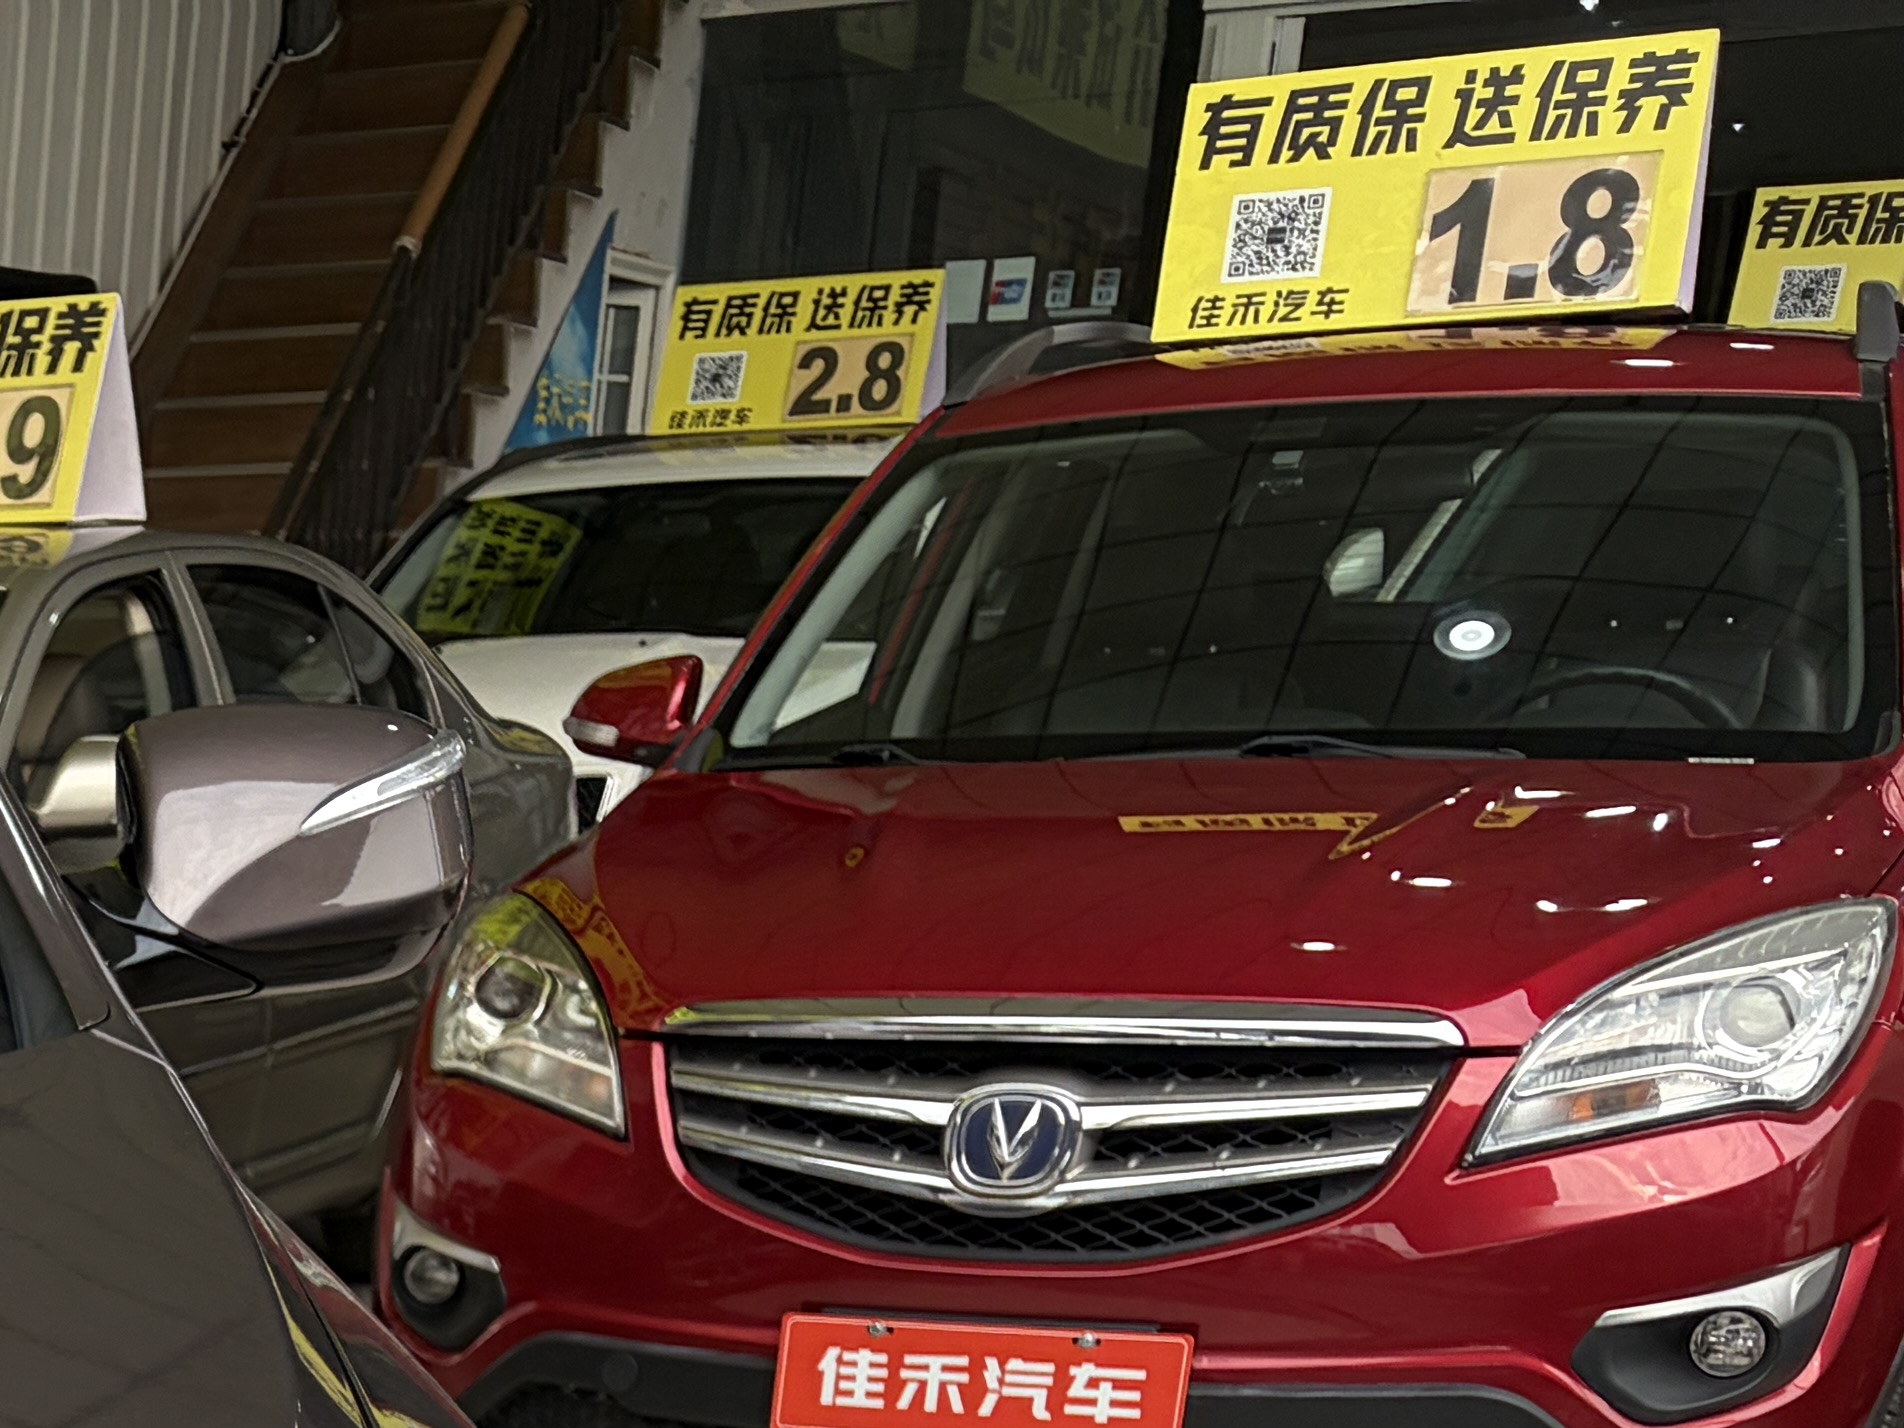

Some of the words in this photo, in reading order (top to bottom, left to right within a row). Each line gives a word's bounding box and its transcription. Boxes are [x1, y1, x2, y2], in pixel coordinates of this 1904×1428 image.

[1197, 75, 1432, 171] 有质保
[1442, 48, 1700, 150] 送保养
[1428, 168, 1640, 307] 1.8
[677, 290, 800, 341] 有质保
[806, 279, 936, 332] 送保养
[1189, 286, 1350, 329] 佳禾汽车
[788, 341, 905, 417] 2.8
[817, 1345, 1147, 1424] 佳禾汽车
